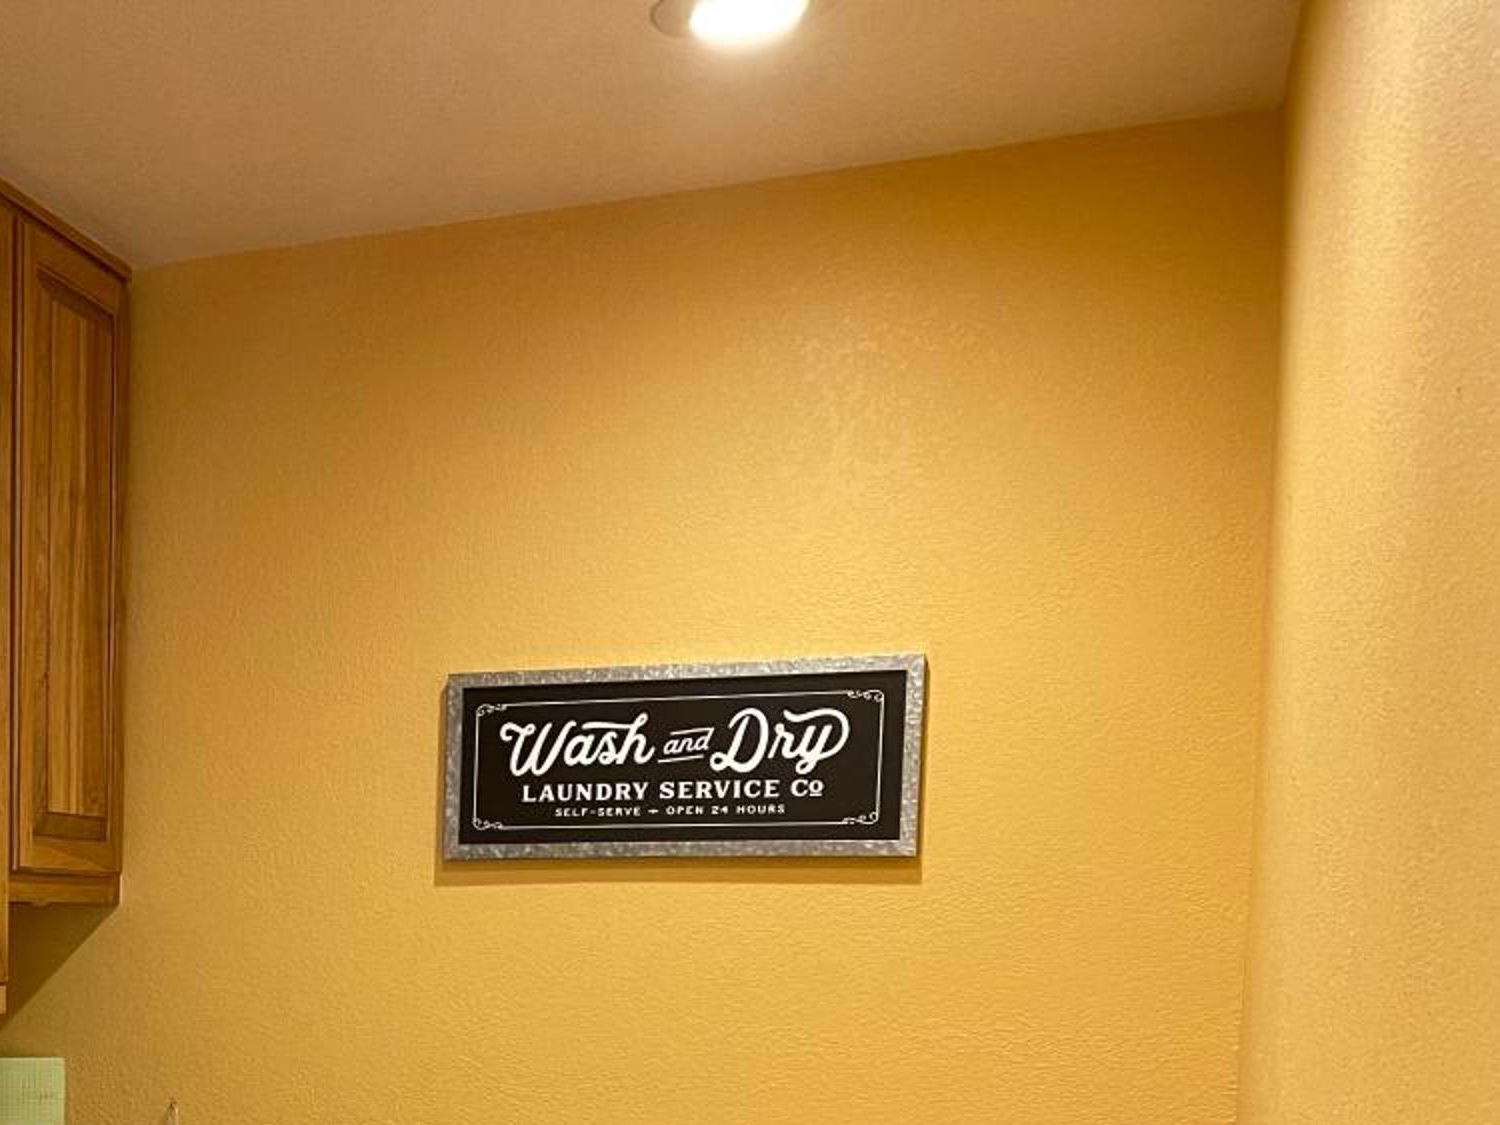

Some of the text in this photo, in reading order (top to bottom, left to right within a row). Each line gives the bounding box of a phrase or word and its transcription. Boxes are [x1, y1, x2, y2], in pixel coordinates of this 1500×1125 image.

[500, 707, 850, 776] Wash and Dry
[522, 782, 649, 803] LAUNDRY
[659, 779, 781, 799] SERVICE
[555, 806, 641, 817] SELF-SERVE
[665, 805, 703, 815] OPEN
[711, 805, 729, 815] 24
[736, 803, 786, 815] HOURS
